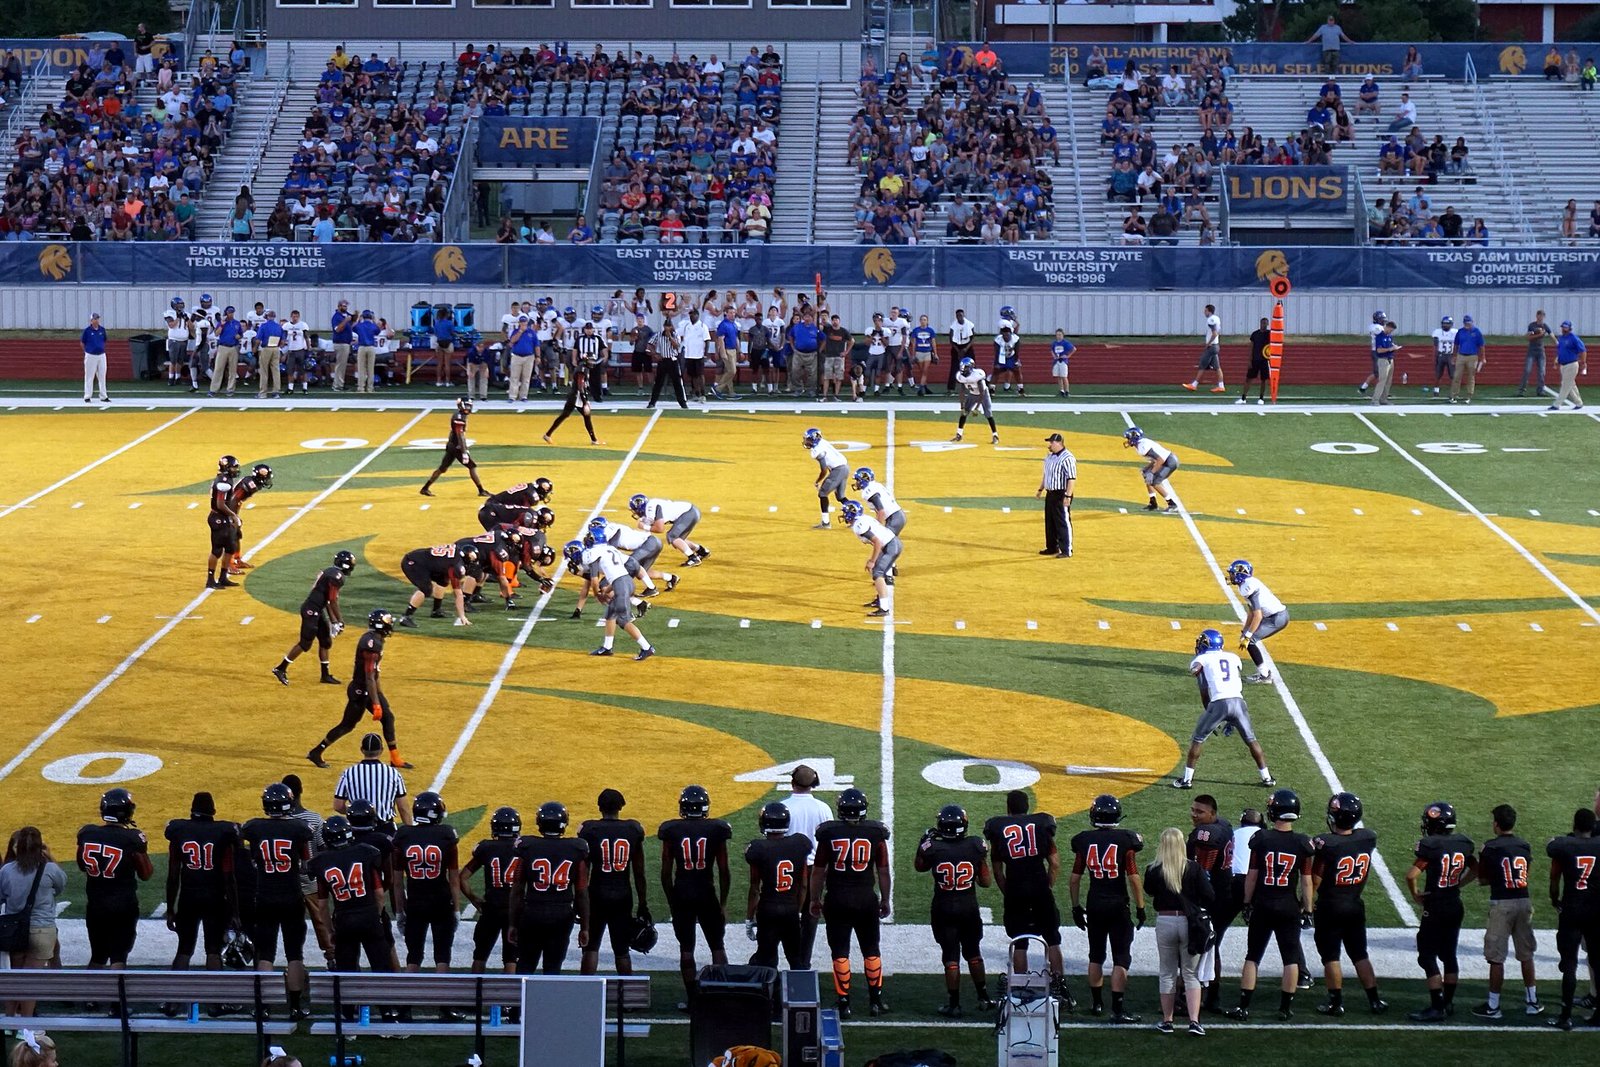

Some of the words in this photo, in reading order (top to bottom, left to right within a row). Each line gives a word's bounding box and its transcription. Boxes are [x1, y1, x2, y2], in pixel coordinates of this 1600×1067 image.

[1050, 46, 1079, 58] 223
[1100, 46, 1233, 58] LL-AMERICAN
[1049, 63, 1080, 74] 300
[1284, 63, 1393, 75] SELETIONS
[499, 127, 569, 149] ARE
[1229, 176, 1343, 199] LIONS
[185, 257, 259, 267] TEACHERS
[264, 258, 326, 268] COLLEGE
[189, 246, 225, 256] EAST
[230, 246, 275, 256] TEXAS
[280, 246, 322, 257] STATE
[616, 248, 652, 259] EAST
[657, 248, 702, 259] TEXAS
[707, 248, 749, 259] STATE
[654, 260, 717, 270] COLLEGE
[1008, 250, 1045, 261] EAST
[1050, 250, 1095, 261] TEXAS
[1100, 250, 1143, 261] STATE
[1427, 252, 1473, 262] TEXAS
[1478, 252, 1510, 262] A&M
[1515, 252, 1600, 263] UNIVERSITY
[226, 269, 286, 279] 1923-1957
[653, 271, 713, 281] 1957-1962
[1033, 262, 1118, 272] UNIVERSITY
[1045, 273, 1106, 283] 1962-1996
[1464, 275, 1563, 285] 1996-PRESENT
[1472, 263, 1555, 274] COMMERCE
[665, 292, 675, 309] 2
[1220, 659, 1230, 682] 9
[42, 752, 163, 785] 0
[921, 758, 1042, 792] 0
[182, 841, 214, 870] 31
[601, 838, 630, 872] 10
[681, 837, 707, 870] 11
[831, 838, 872, 872] 70
[1003, 823, 1038, 859] 21
[83, 842, 123, 879] 57
[260, 839, 292, 873] 15
[406, 844, 442, 880] 29
[1086, 843, 1118, 879] 44
[1265, 852, 1296, 886] 17
[1335, 852, 1371, 886] 23
[1438, 852, 1465, 888] 12
[324, 862, 367, 901] 24
[491, 856, 522, 888] 14
[532, 858, 573, 891] 34
[775, 859, 794, 892] 6
[936, 861, 974, 891] 32
[1501, 856, 1528, 889] 13
[1576, 856, 1597, 889] 7
